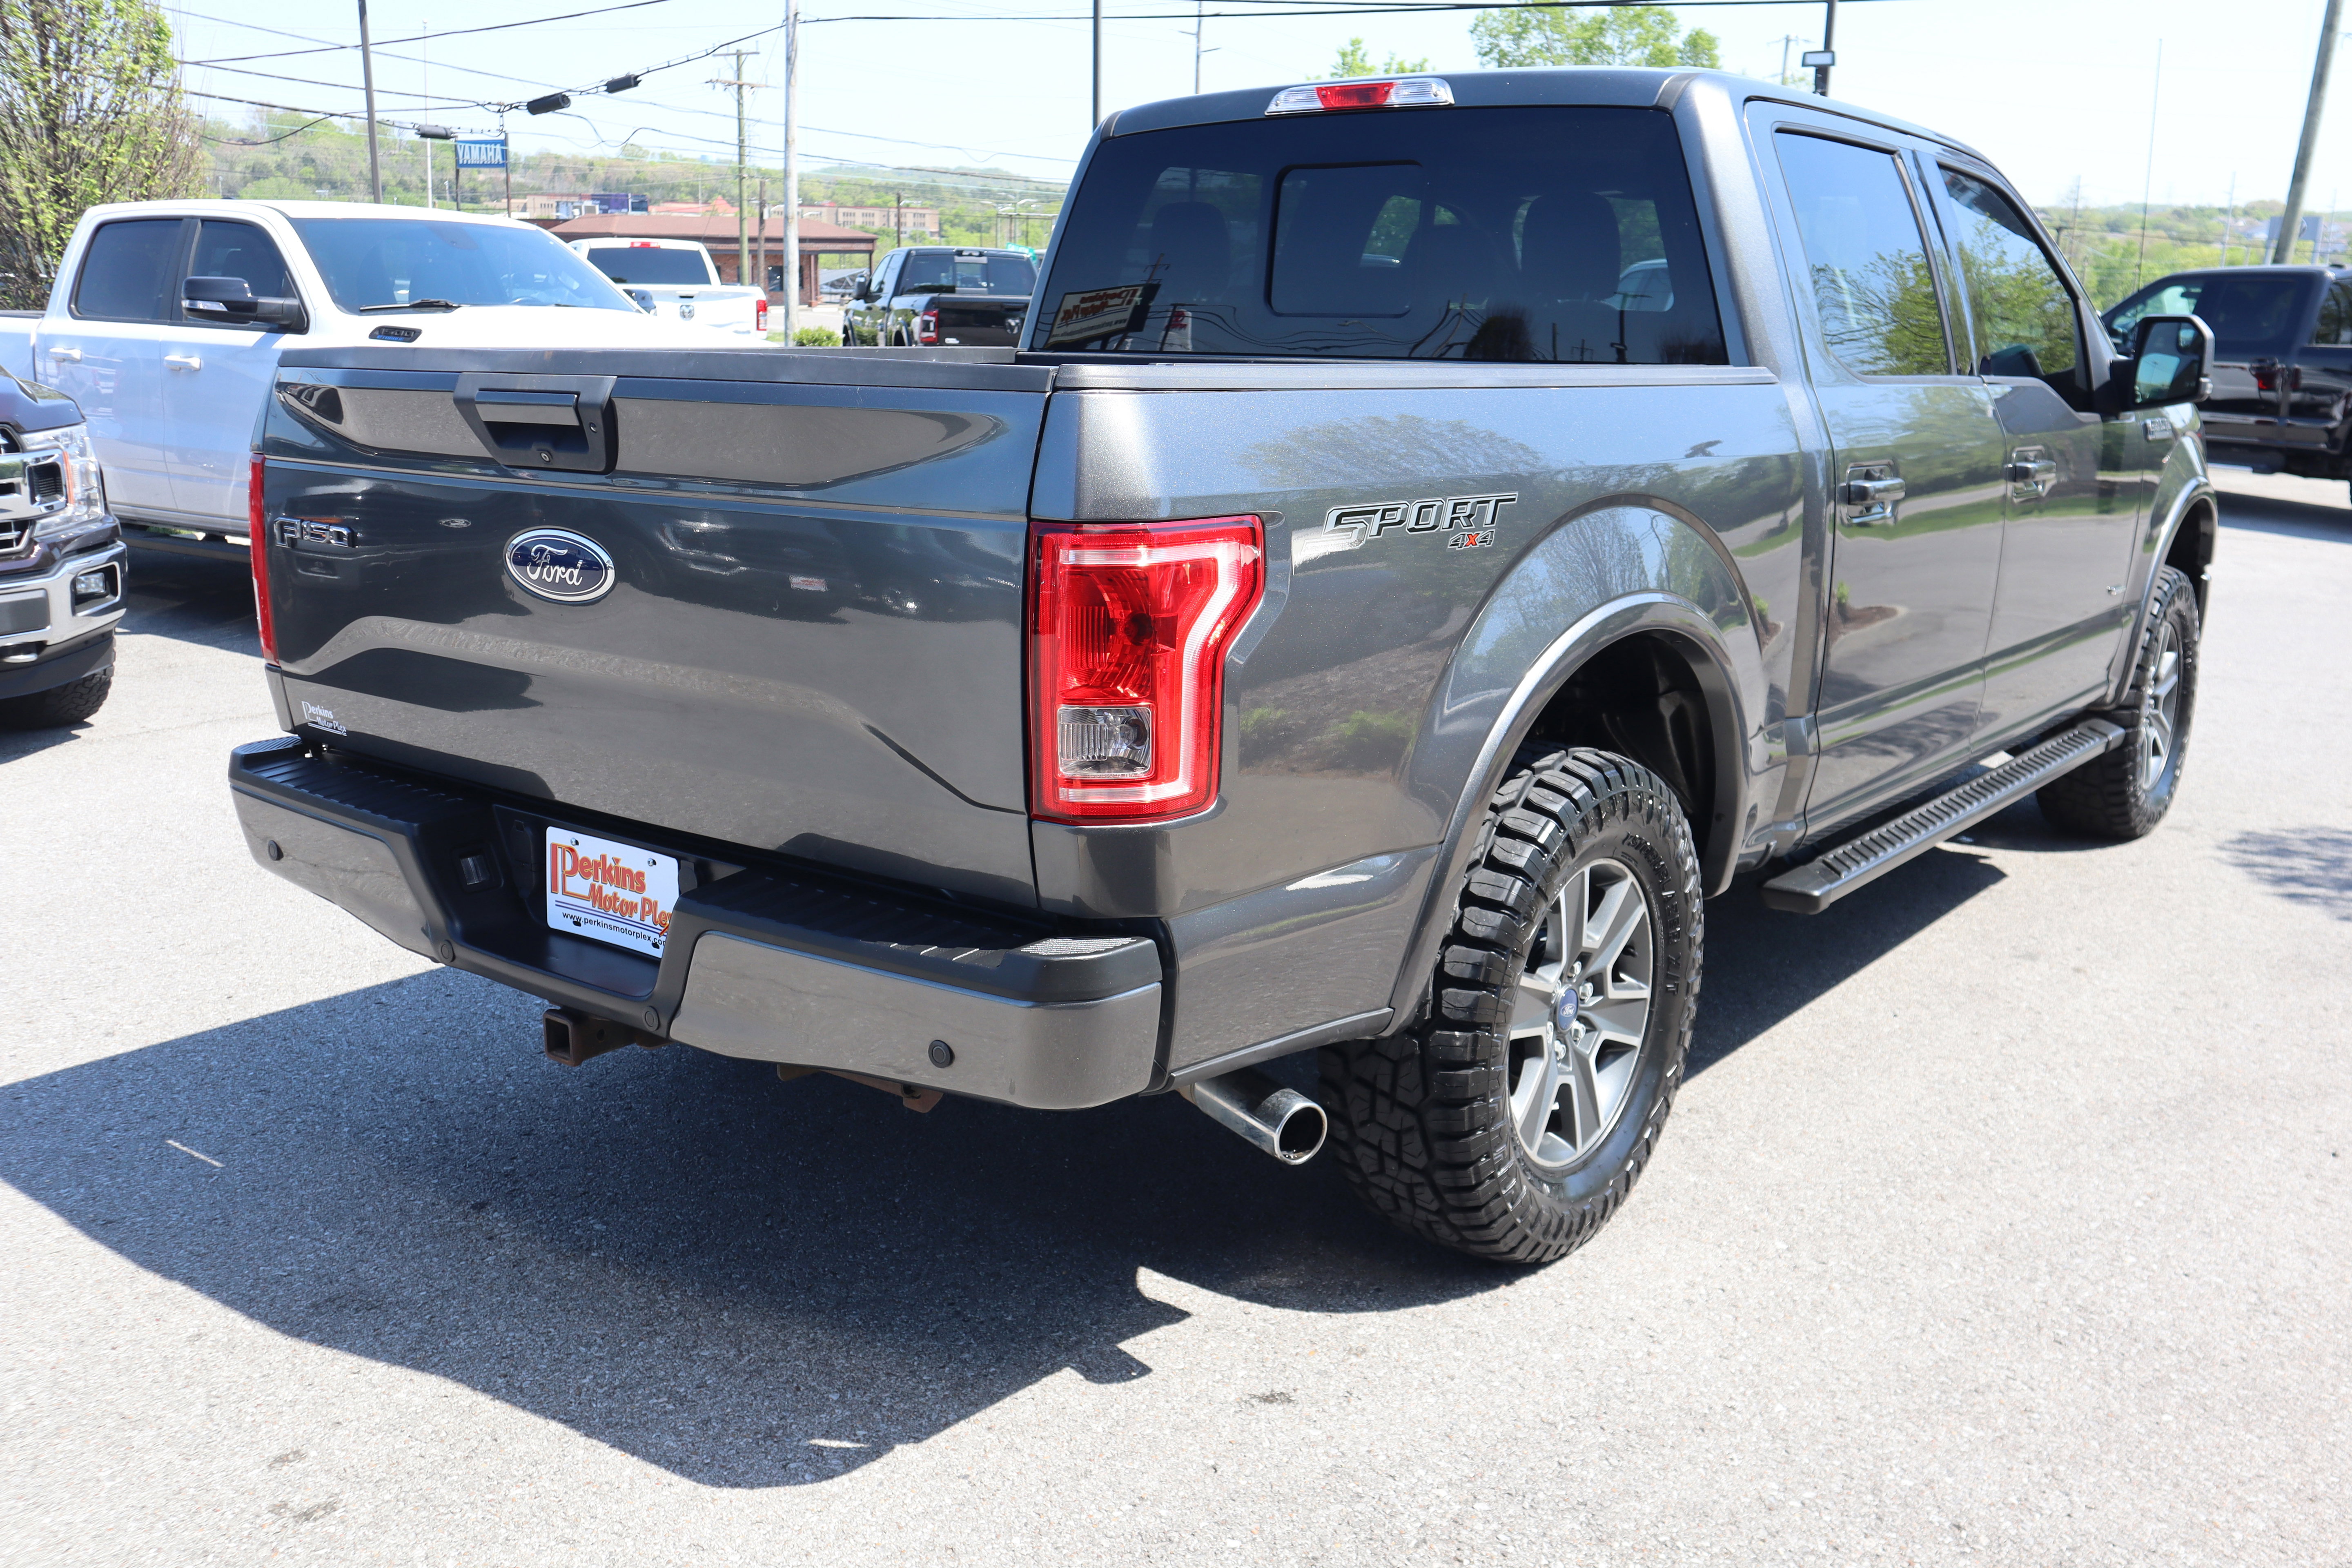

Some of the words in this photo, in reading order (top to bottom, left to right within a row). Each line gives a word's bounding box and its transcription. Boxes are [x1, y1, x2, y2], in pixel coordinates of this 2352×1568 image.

[457, 143, 503, 164] YAMAHA
[1301, 492, 1518, 555] SPORT
[526, 544, 583, 586] Ford
[302, 701, 334, 719] Perkins
[550, 842, 646, 894] Perkins
[588, 883, 638, 917] Motor
